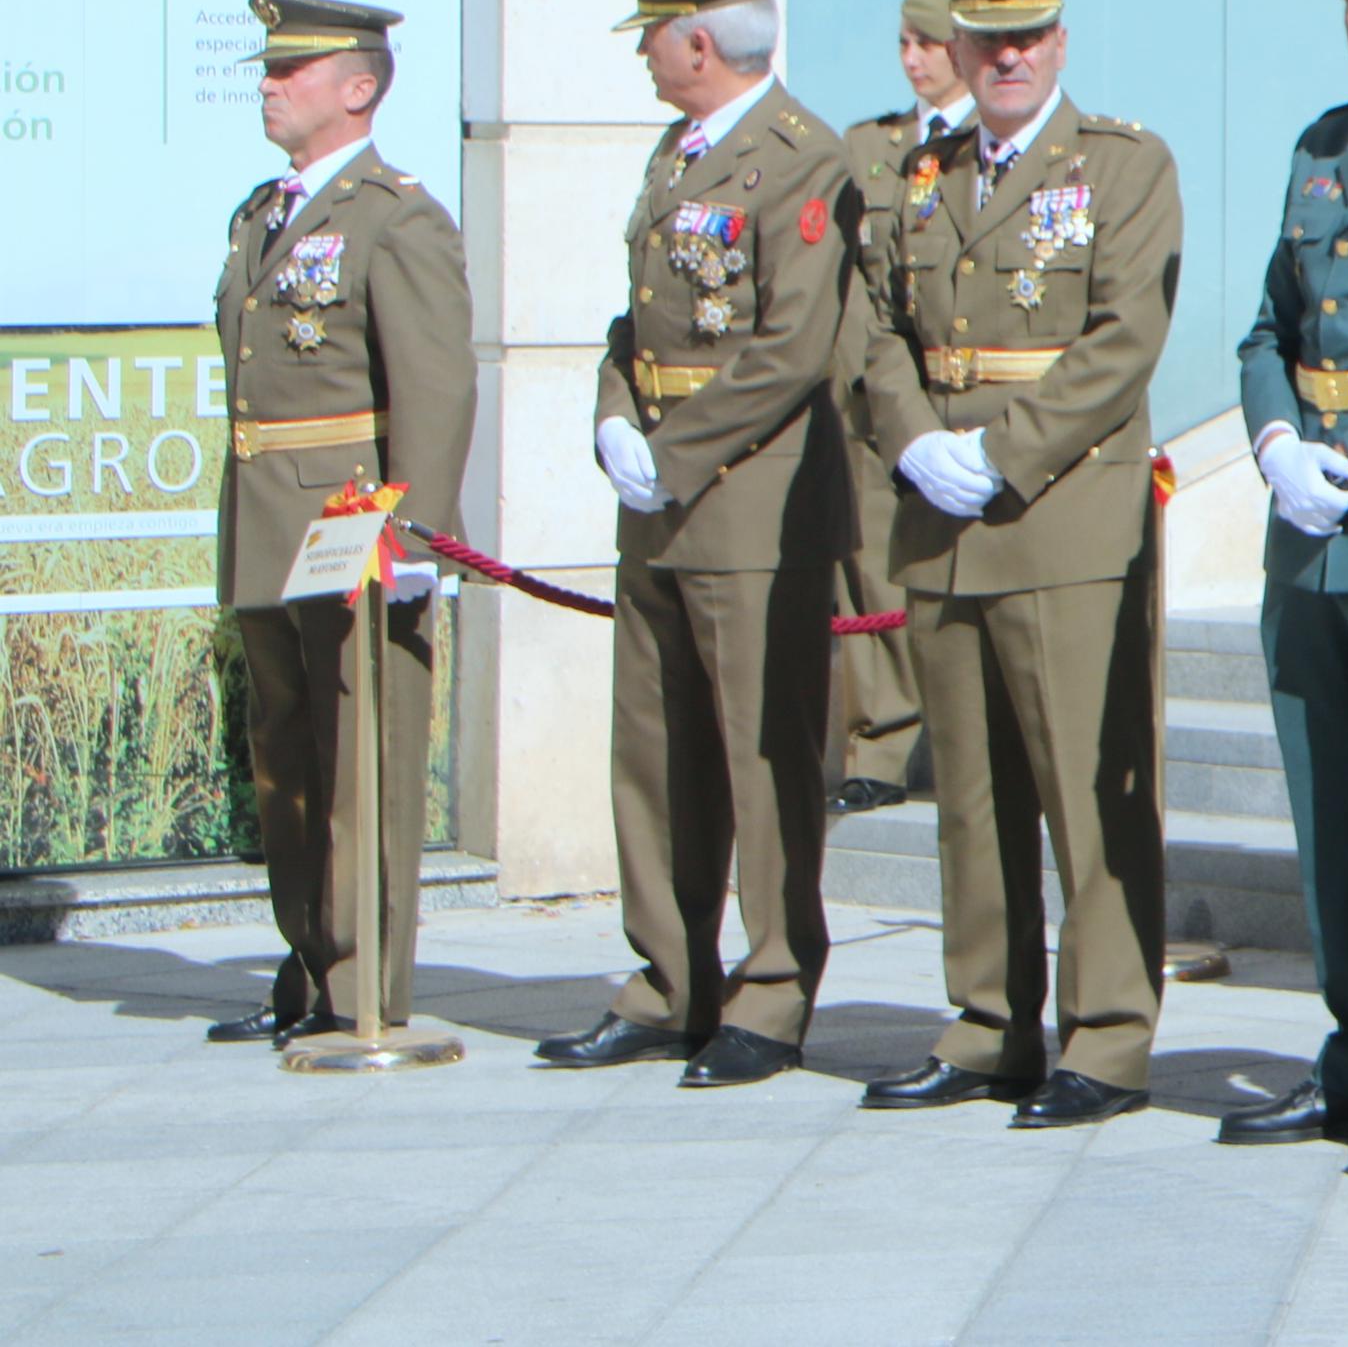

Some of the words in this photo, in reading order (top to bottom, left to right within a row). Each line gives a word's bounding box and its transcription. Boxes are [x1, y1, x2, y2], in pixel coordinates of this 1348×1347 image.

[196, 65, 216, 77] en
[223, 61, 237, 77] el
[196, 87, 216, 103] de
[0, 430, 203, 497] GRO
